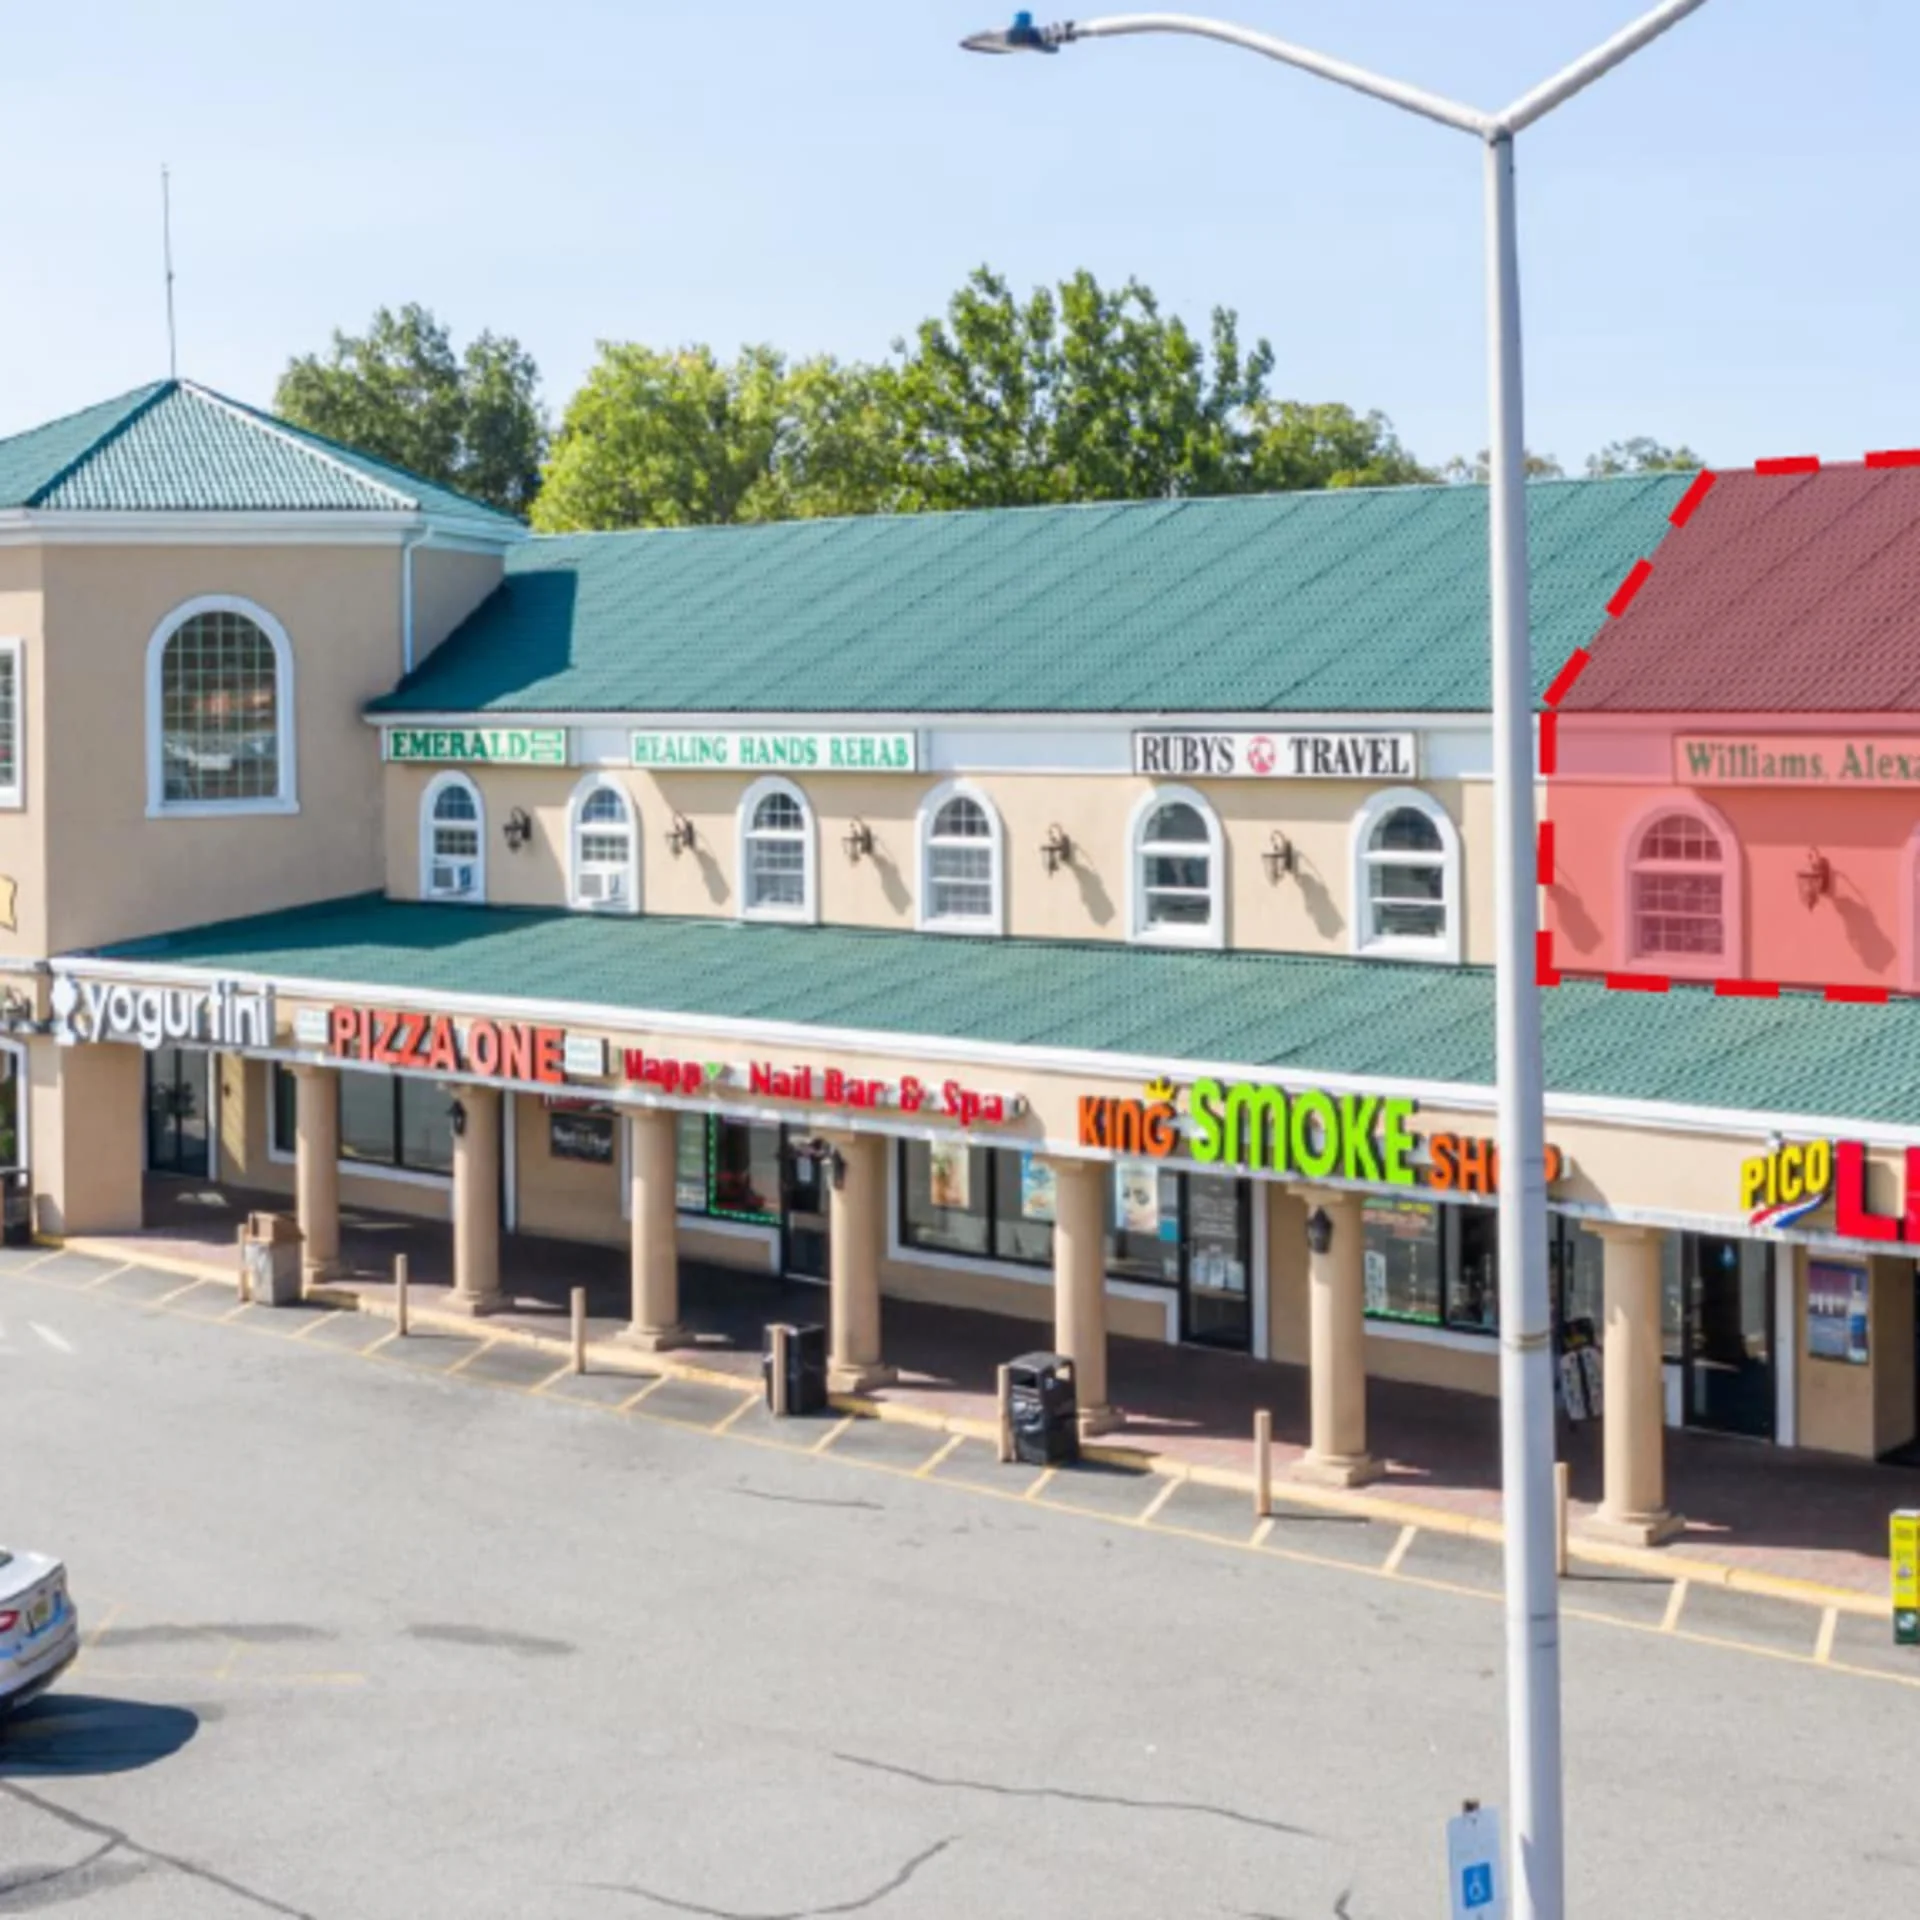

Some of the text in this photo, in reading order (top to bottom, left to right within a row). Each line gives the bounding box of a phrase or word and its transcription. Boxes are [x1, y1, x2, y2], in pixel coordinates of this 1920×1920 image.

[391, 731, 528, 758] EMERALD
[634, 734, 910, 768] HEALING HANDS REHAB
[1140, 735, 1410, 775] RUBYS TRAVEL
[80, 979, 272, 1050] yogurtini
[331, 1004, 458, 1072] PIZZA
[467, 1017, 563, 1085] ONE
[748, 1060, 812, 1101] Nail
[824, 1067, 888, 1109] Bar
[899, 1076, 926, 1113] &
[942, 1080, 1004, 1127] Spa
[1078, 1076, 1560, 1195] KING SMOKE SH
[1740, 1137, 1832, 1212] PICO
[1836, 1140, 1920, 1245] L
